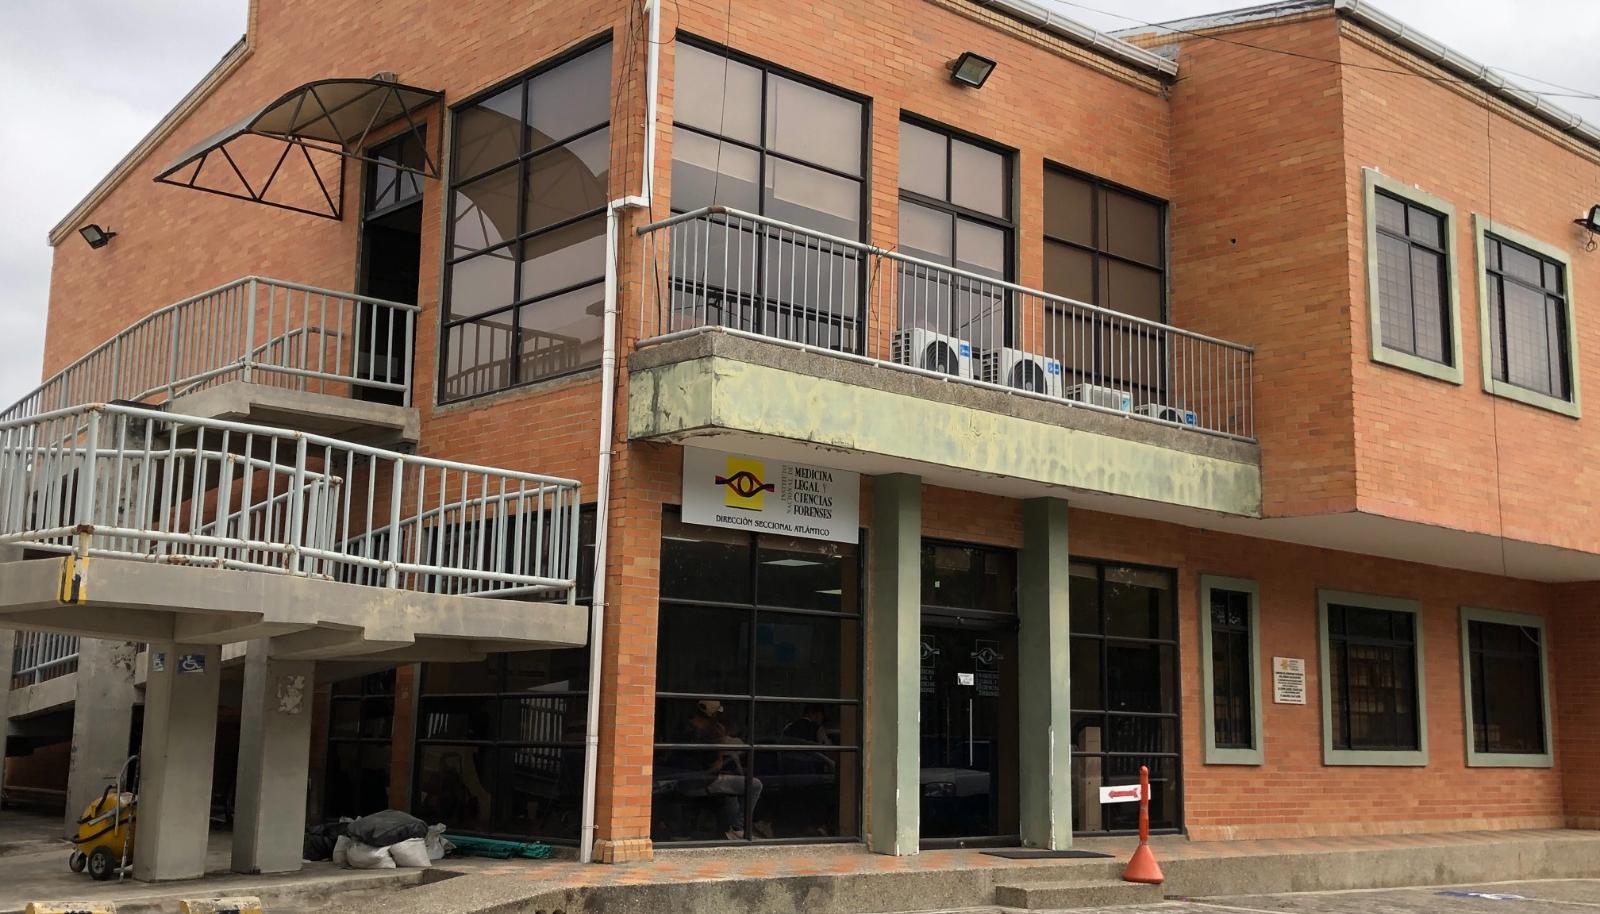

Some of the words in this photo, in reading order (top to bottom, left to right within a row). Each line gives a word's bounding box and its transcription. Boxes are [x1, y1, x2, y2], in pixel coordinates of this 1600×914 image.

[795, 467, 832, 482] MEDICINA
[795, 479, 819, 492] LEGAL
[794, 492, 832, 506] CIENCIAS
[794, 505, 832, 519] FORENSES
[716, 514, 753, 526] DIRECCIÓN
[755, 520, 792, 532] SECCIONAL
[795, 525, 829, 536] ATLÁNTICO
